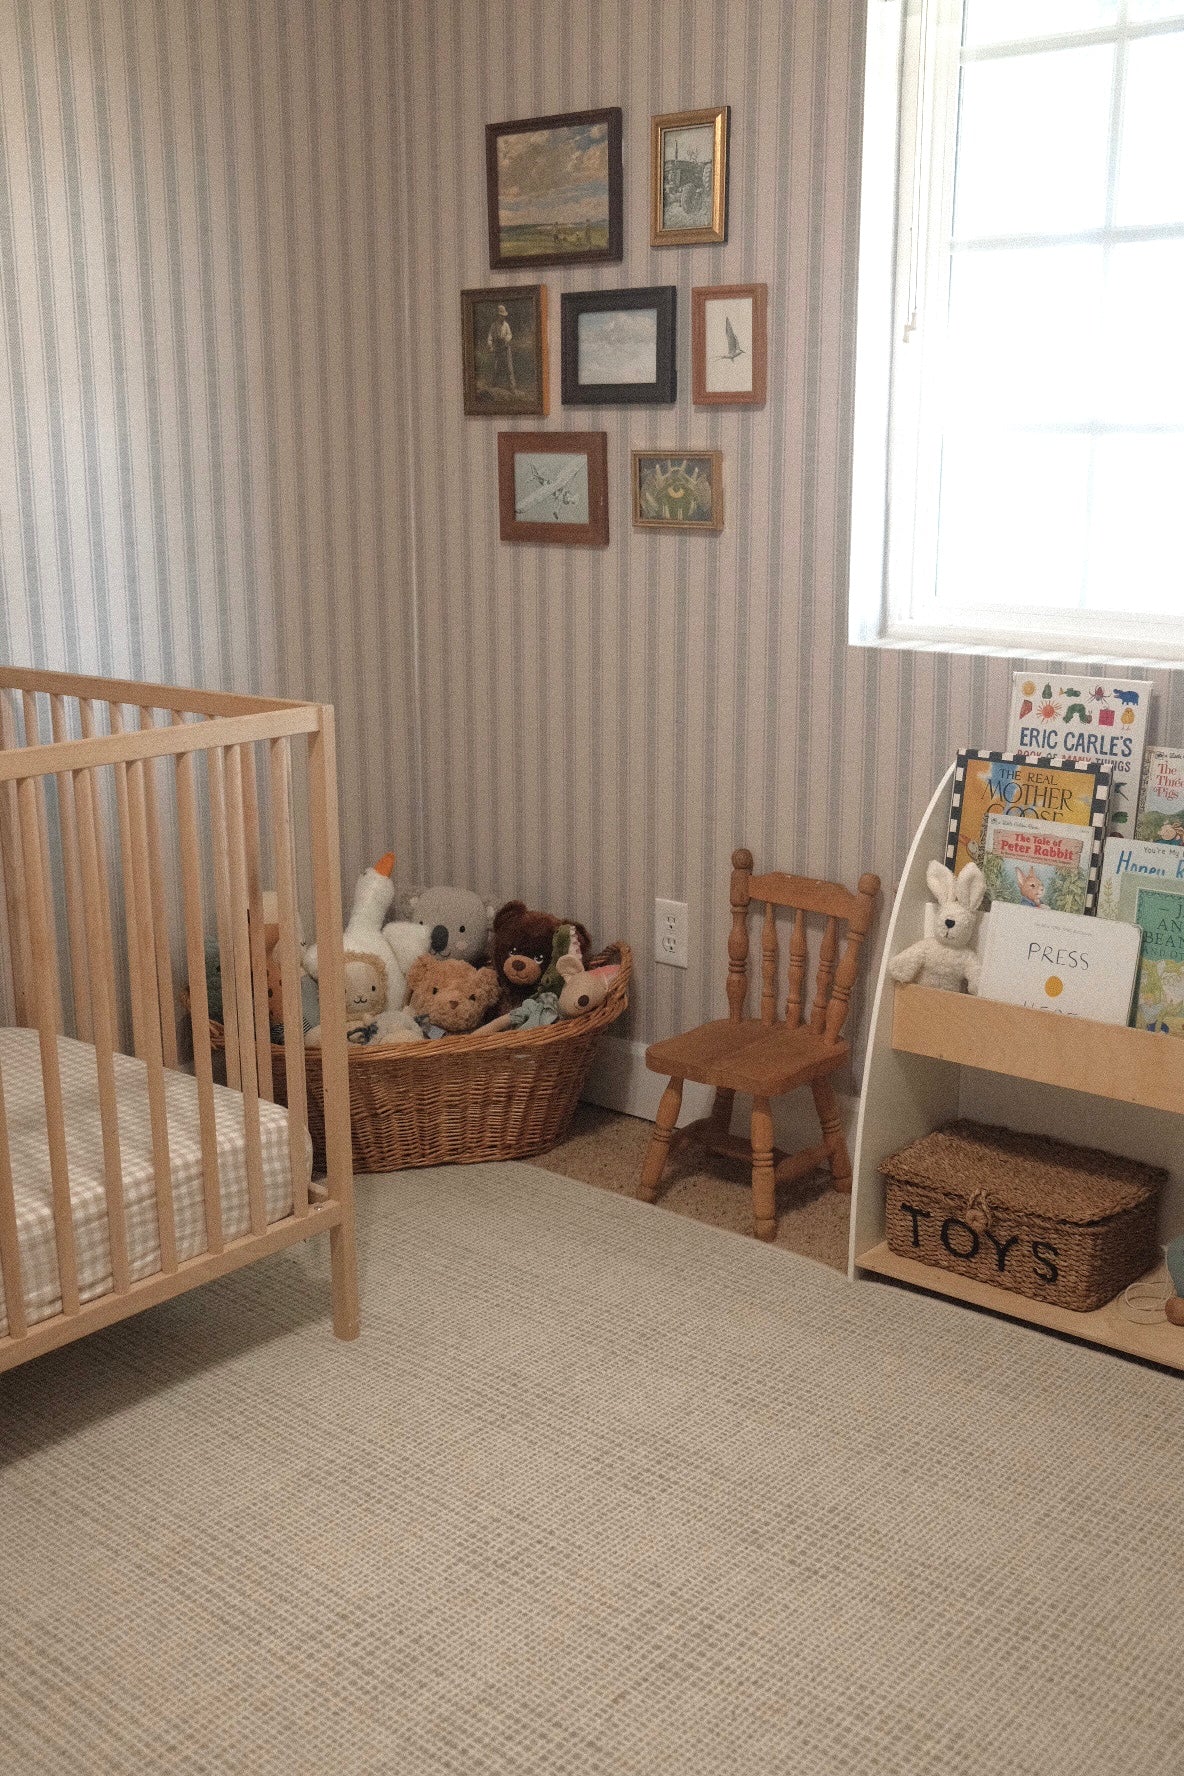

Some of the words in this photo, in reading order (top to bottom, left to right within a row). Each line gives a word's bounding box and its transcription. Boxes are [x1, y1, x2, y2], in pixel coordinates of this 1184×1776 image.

[1020, 727, 1058, 749] ERIC
[1063, 731, 1132, 757] CARLE'S
[1000, 768, 1021, 781] THE
[1028, 772, 1058, 786] REAL
[1158, 763, 1177, 775] The
[980, 778, 1073, 812] MOTHER
[1155, 786, 1179, 801] Pigs
[1015, 833, 1031, 843] The
[1033, 836, 1050, 846] Tale
[1053, 839, 1063, 847] of
[1000, 840, 1031, 854] Peter
[1034, 845, 1073, 860] Rabbit
[1144, 846, 1166, 855] You're
[1169, 849, 1180, 859] My
[1028, 942, 1089, 970] PRESS
[901, 1202, 1061, 1284] TOYS
